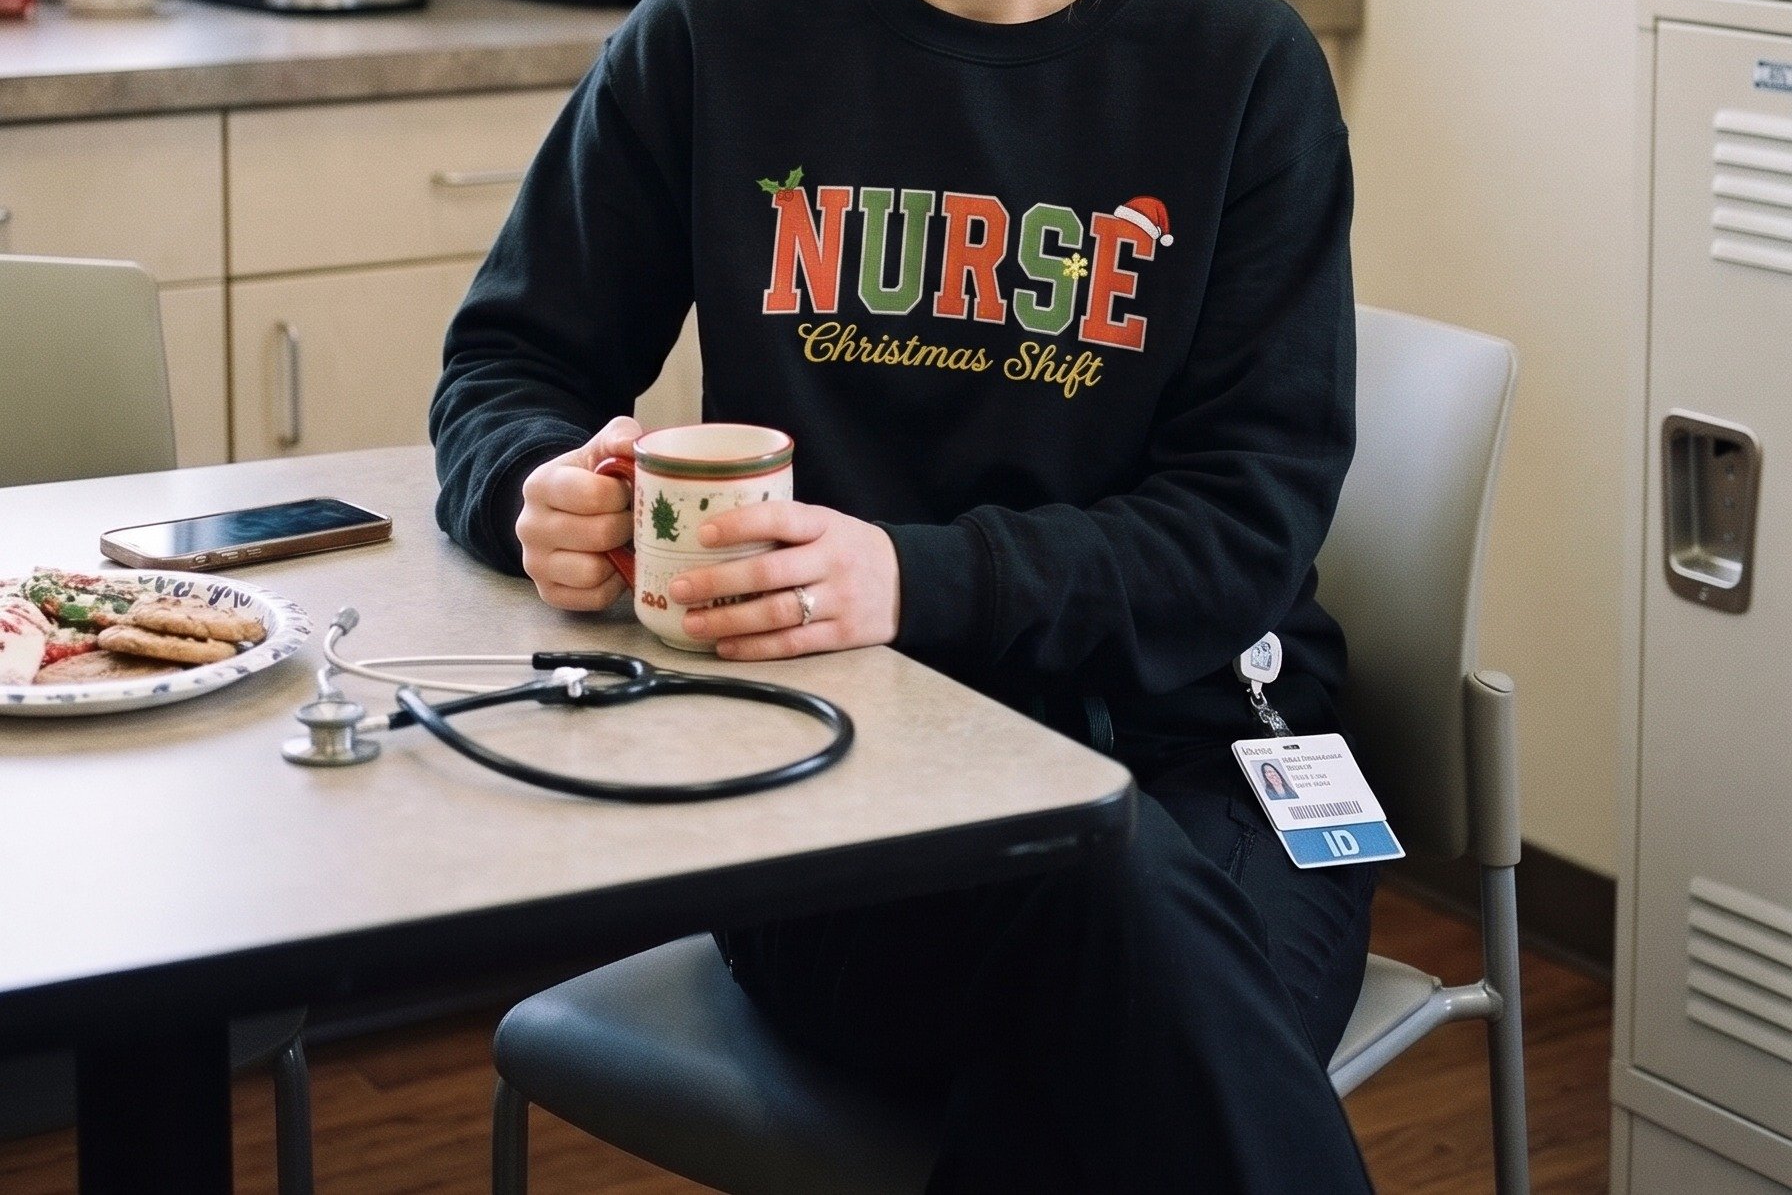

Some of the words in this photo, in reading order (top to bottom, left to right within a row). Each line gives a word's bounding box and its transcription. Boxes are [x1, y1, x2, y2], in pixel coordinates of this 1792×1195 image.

[762, 185, 1157, 353] NURSE
[797, 321, 994, 373] Christmas
[1003, 340, 1104, 399] Shift
[1321, 828, 1360, 858] ID
